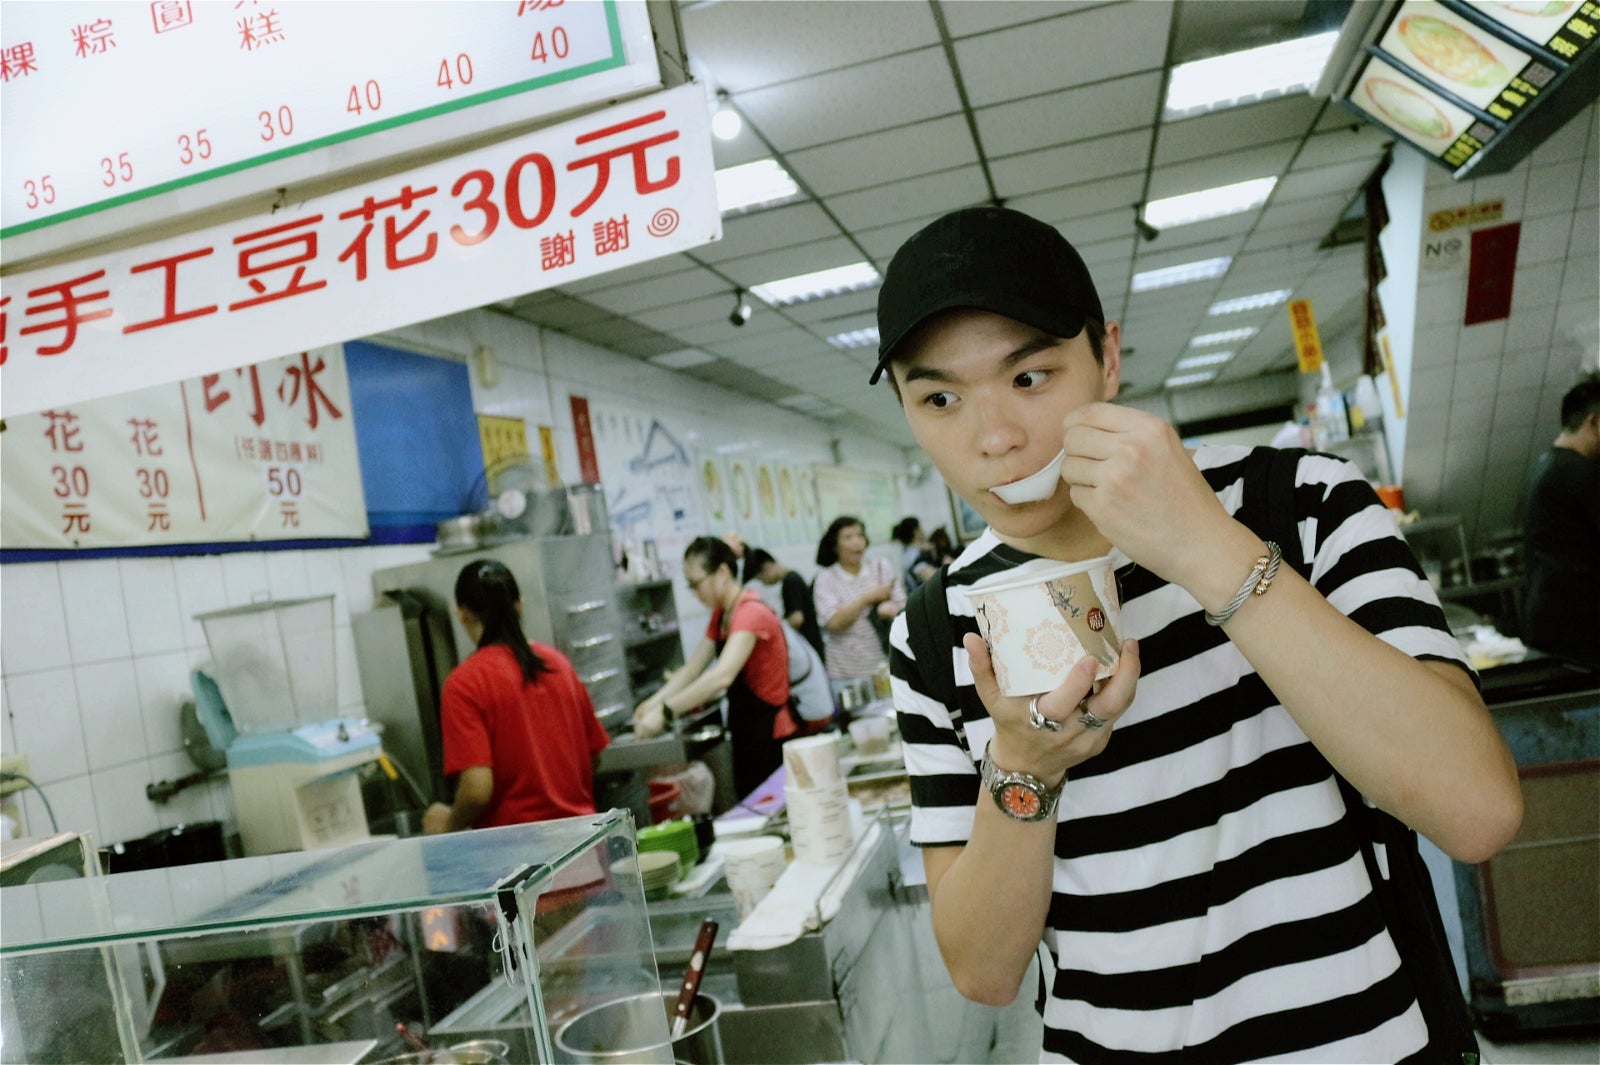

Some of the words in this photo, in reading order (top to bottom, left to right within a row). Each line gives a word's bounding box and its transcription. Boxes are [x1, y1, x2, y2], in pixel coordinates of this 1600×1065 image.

[71, 18, 116, 58] 粽
[234, 0, 285, 51] 糕
[0, 42, 38, 82] 粿
[530, 26, 569, 64] 40
[436, 53, 473, 89] 40
[346, 80, 382, 115] 40
[258, 105, 294, 142] 30
[177, 129, 212, 165] 35
[101, 152, 134, 187] 35
[24, 175, 56, 210] 35
[0, 109, 681, 368] 手工豆花30元
[540, 214, 629, 271] 謝謝
[41, 409, 84, 453] 花
[127, 417, 163, 456] 花
[52, 465, 89, 498] 30
[136, 468, 169, 498] 30
[268, 467, 302, 496] 50
[62, 503, 91, 534] 元
[148, 503, 171, 532] 元
[280, 502, 300, 527] 元
